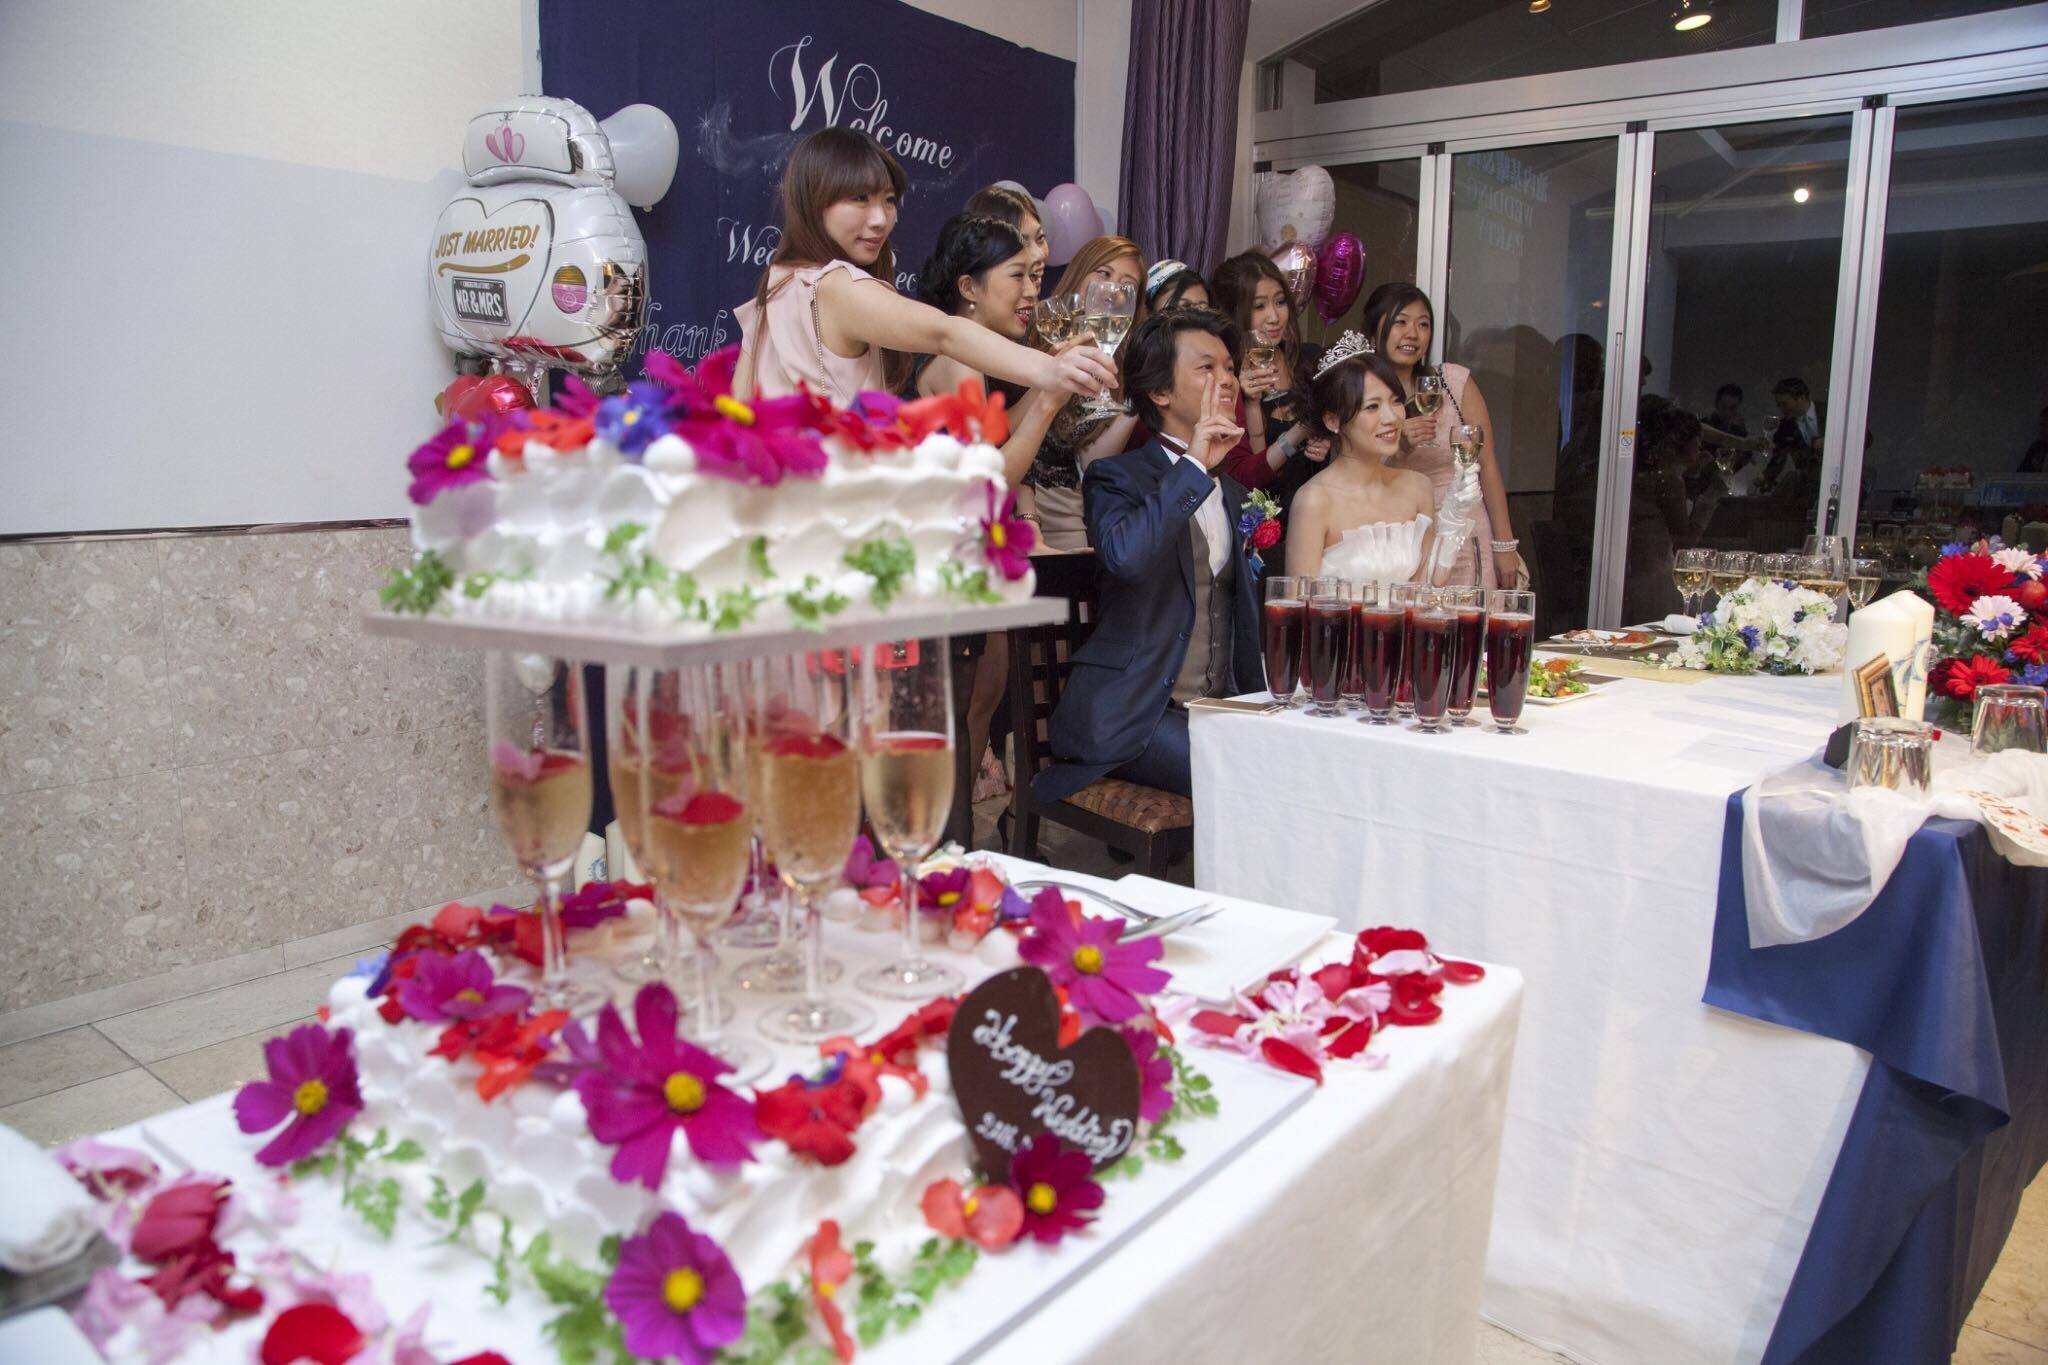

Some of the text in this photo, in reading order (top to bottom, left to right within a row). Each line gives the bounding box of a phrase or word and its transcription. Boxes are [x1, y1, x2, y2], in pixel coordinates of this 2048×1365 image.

[435, 224, 540, 258] JUST MARRIED!
[633, 302, 728, 361] hank
[972, 1008, 1075, 1096] Happy
